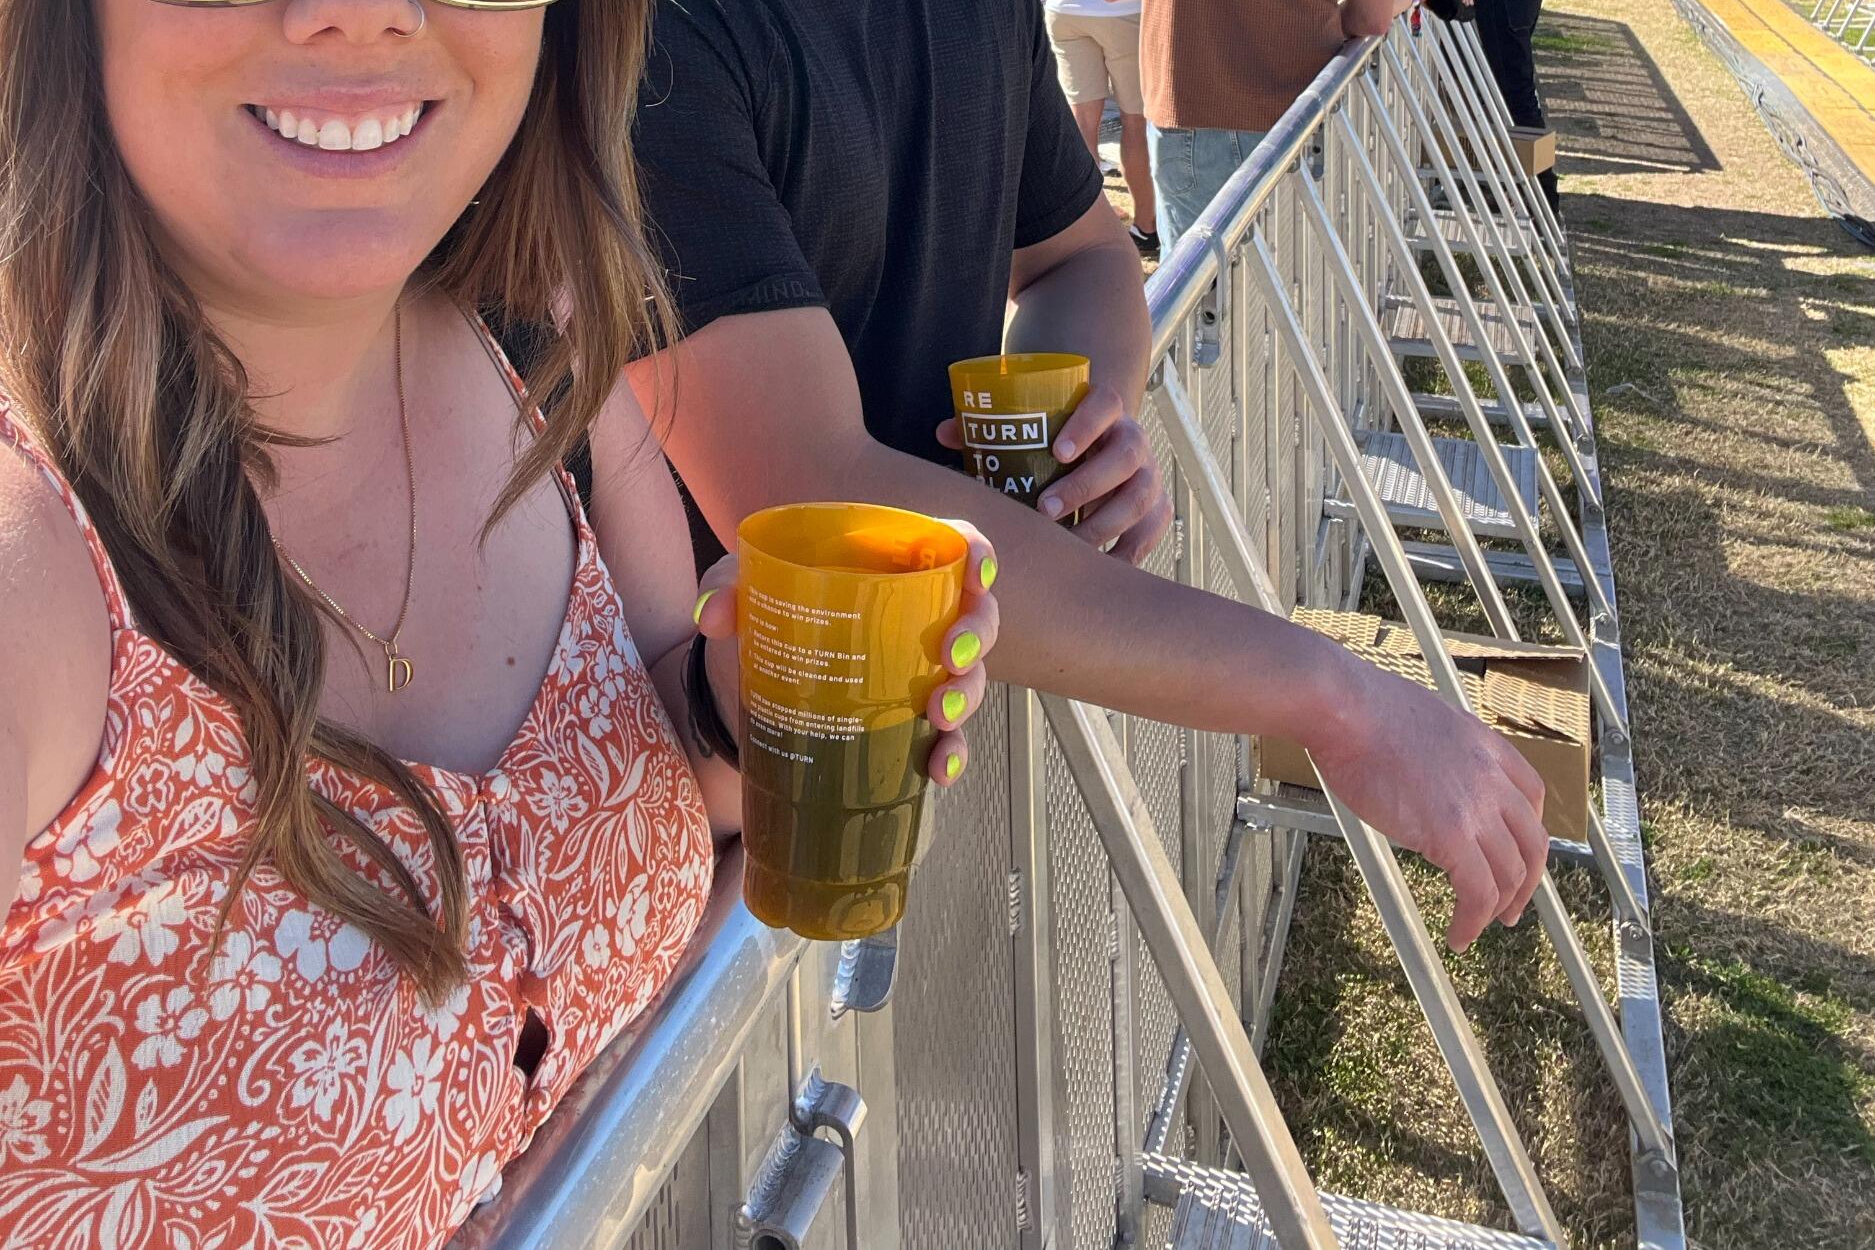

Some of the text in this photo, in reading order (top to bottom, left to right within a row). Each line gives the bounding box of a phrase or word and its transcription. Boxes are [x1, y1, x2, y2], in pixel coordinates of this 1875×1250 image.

[963, 391, 992, 408] RE
[968, 422, 1039, 440] TURN
[973, 453, 1000, 472] TO
[775, 599, 796, 611] saving
[797, 605, 809, 613] the
[811, 609, 861, 619] environment
[782, 610, 790, 618] to
[791, 613, 804, 621] win
[805, 617, 831, 626] prizes.
[782, 651, 790, 659] to
[791, 654, 804, 662] win
[784, 643, 797, 652] cup
[798, 646, 806, 654] to
[814, 649, 835, 658] TURN
[837, 652, 850, 660] Bin
[788, 667, 797, 675] be
[798, 670, 827, 681] cleaned
[797, 710, 825, 721] millions
[789, 716, 804, 726] from
[805, 721, 835, 733] entering
[836, 724, 865, 732] landfills
[793, 728, 808, 736] your
[789, 753, 814, 764] @TURN
